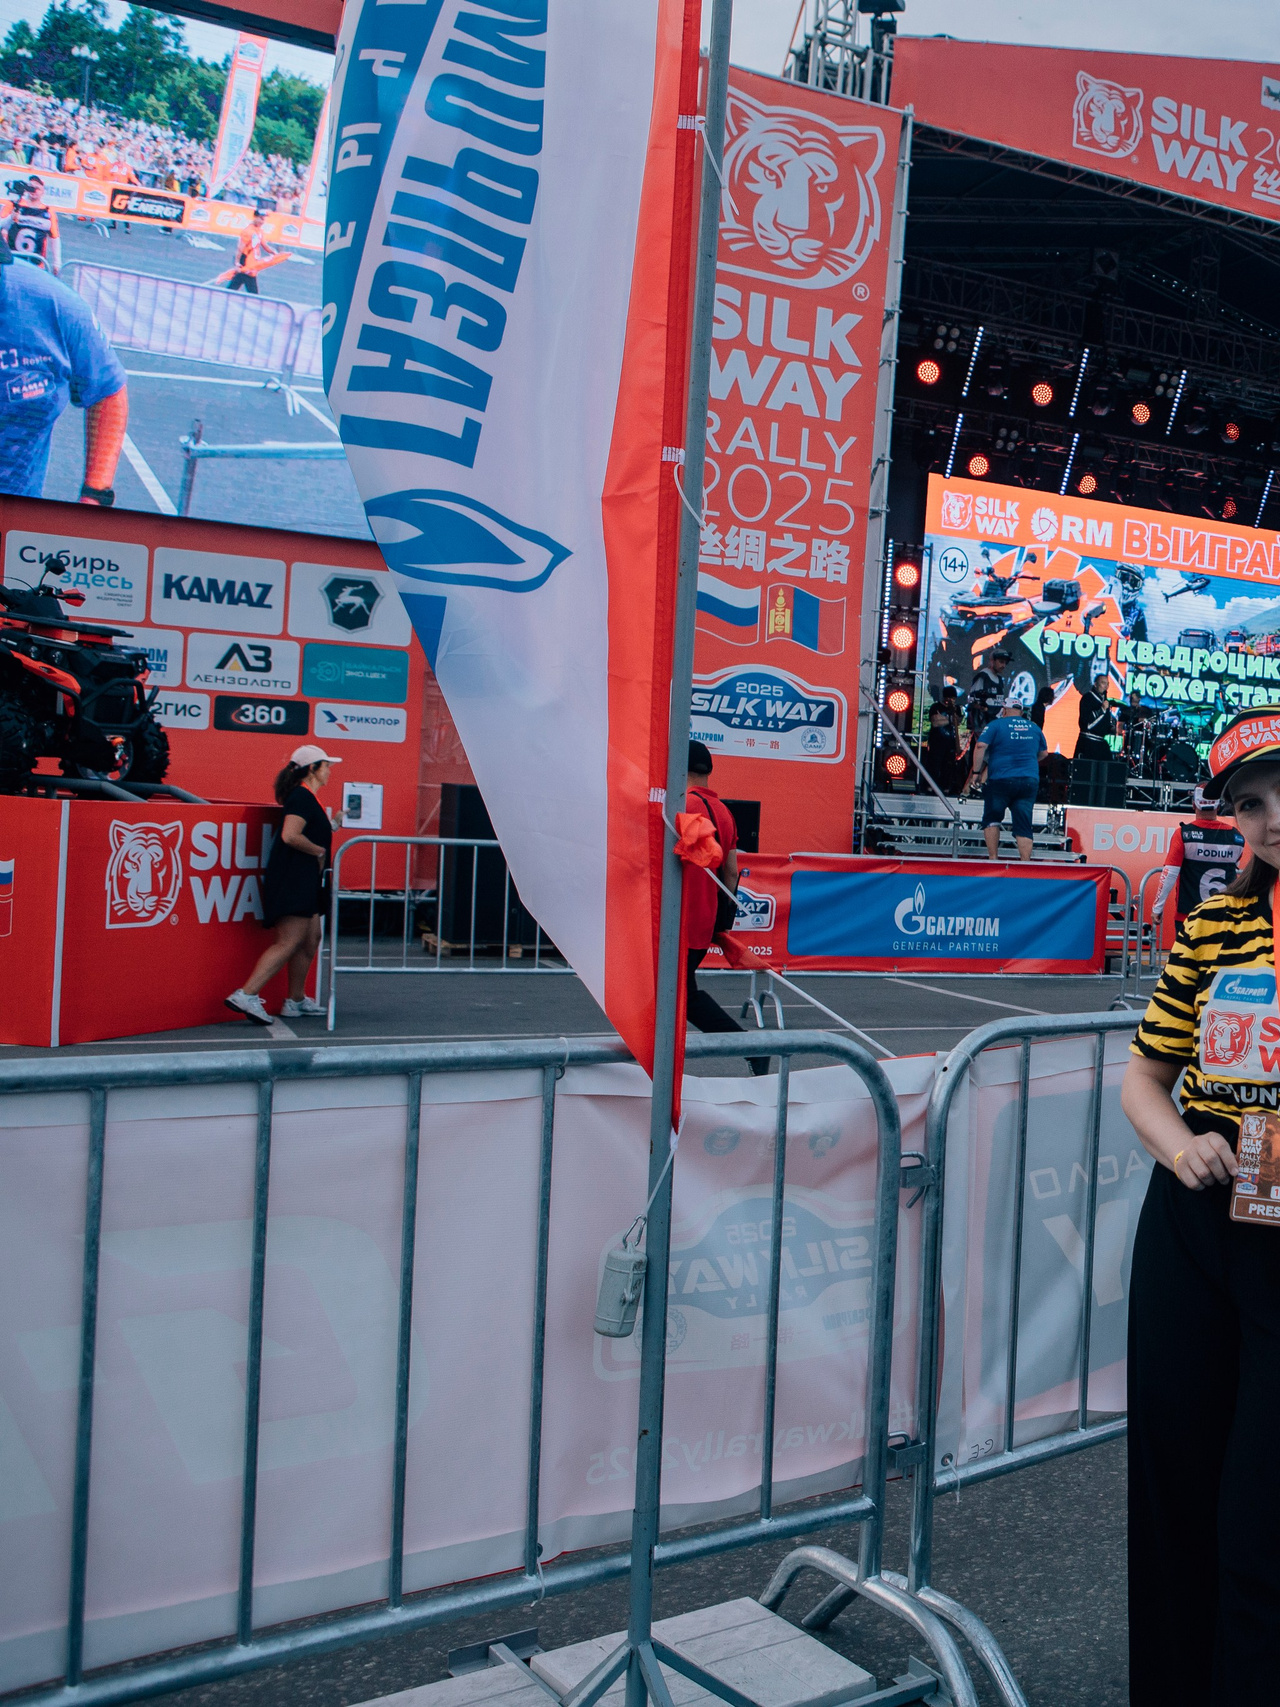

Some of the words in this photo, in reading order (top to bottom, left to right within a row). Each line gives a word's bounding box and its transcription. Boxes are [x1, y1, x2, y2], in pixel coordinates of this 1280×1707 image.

[1151, 96, 1249, 158] SILK
[1151, 133, 1248, 193] WAY
[711, 282, 864, 368] SILK
[708, 348, 862, 423] WAY
[704, 410, 858, 474] RALLY
[702, 456, 856, 536] 2025
[974, 495, 1021, 520] SILK
[974, 515, 1020, 539] WAY
[19, 545, 120, 574] Сибирь
[942, 556, 967, 573] 14+
[59, 571, 134, 590] здесь
[162, 572, 274, 609] KAMAZ
[193, 674, 292, 689] ЛЕНЗОЛОТО
[735, 681, 784, 697] 2025
[152, 701, 202, 718] 2ГИС
[239, 703, 287, 725] 360
[690, 692, 762, 717] SILK
[765, 699, 828, 722] WAY
[343, 714, 400, 726] ТРИКОЛОР
[730, 717, 786, 729] RALLY
[691, 731, 725, 743] GAZPROM
[1197, 848, 1233, 859] PODIUM
[1199, 867, 1228, 902] 6
[189, 875, 266, 924] WA
[925, 916, 1000, 937] GAZPROM
[892, 940, 943, 951] GENERAL
[948, 942, 999, 953] PARTNER
[1234, 987, 1268, 997] GAZPROM
[1241, 1138, 1263, 1147] SILK
[1241, 1146, 1262, 1155] WAY
[1239, 1159, 1261, 1168] 2025
[1274, 1188, 1279, 1197] 1
